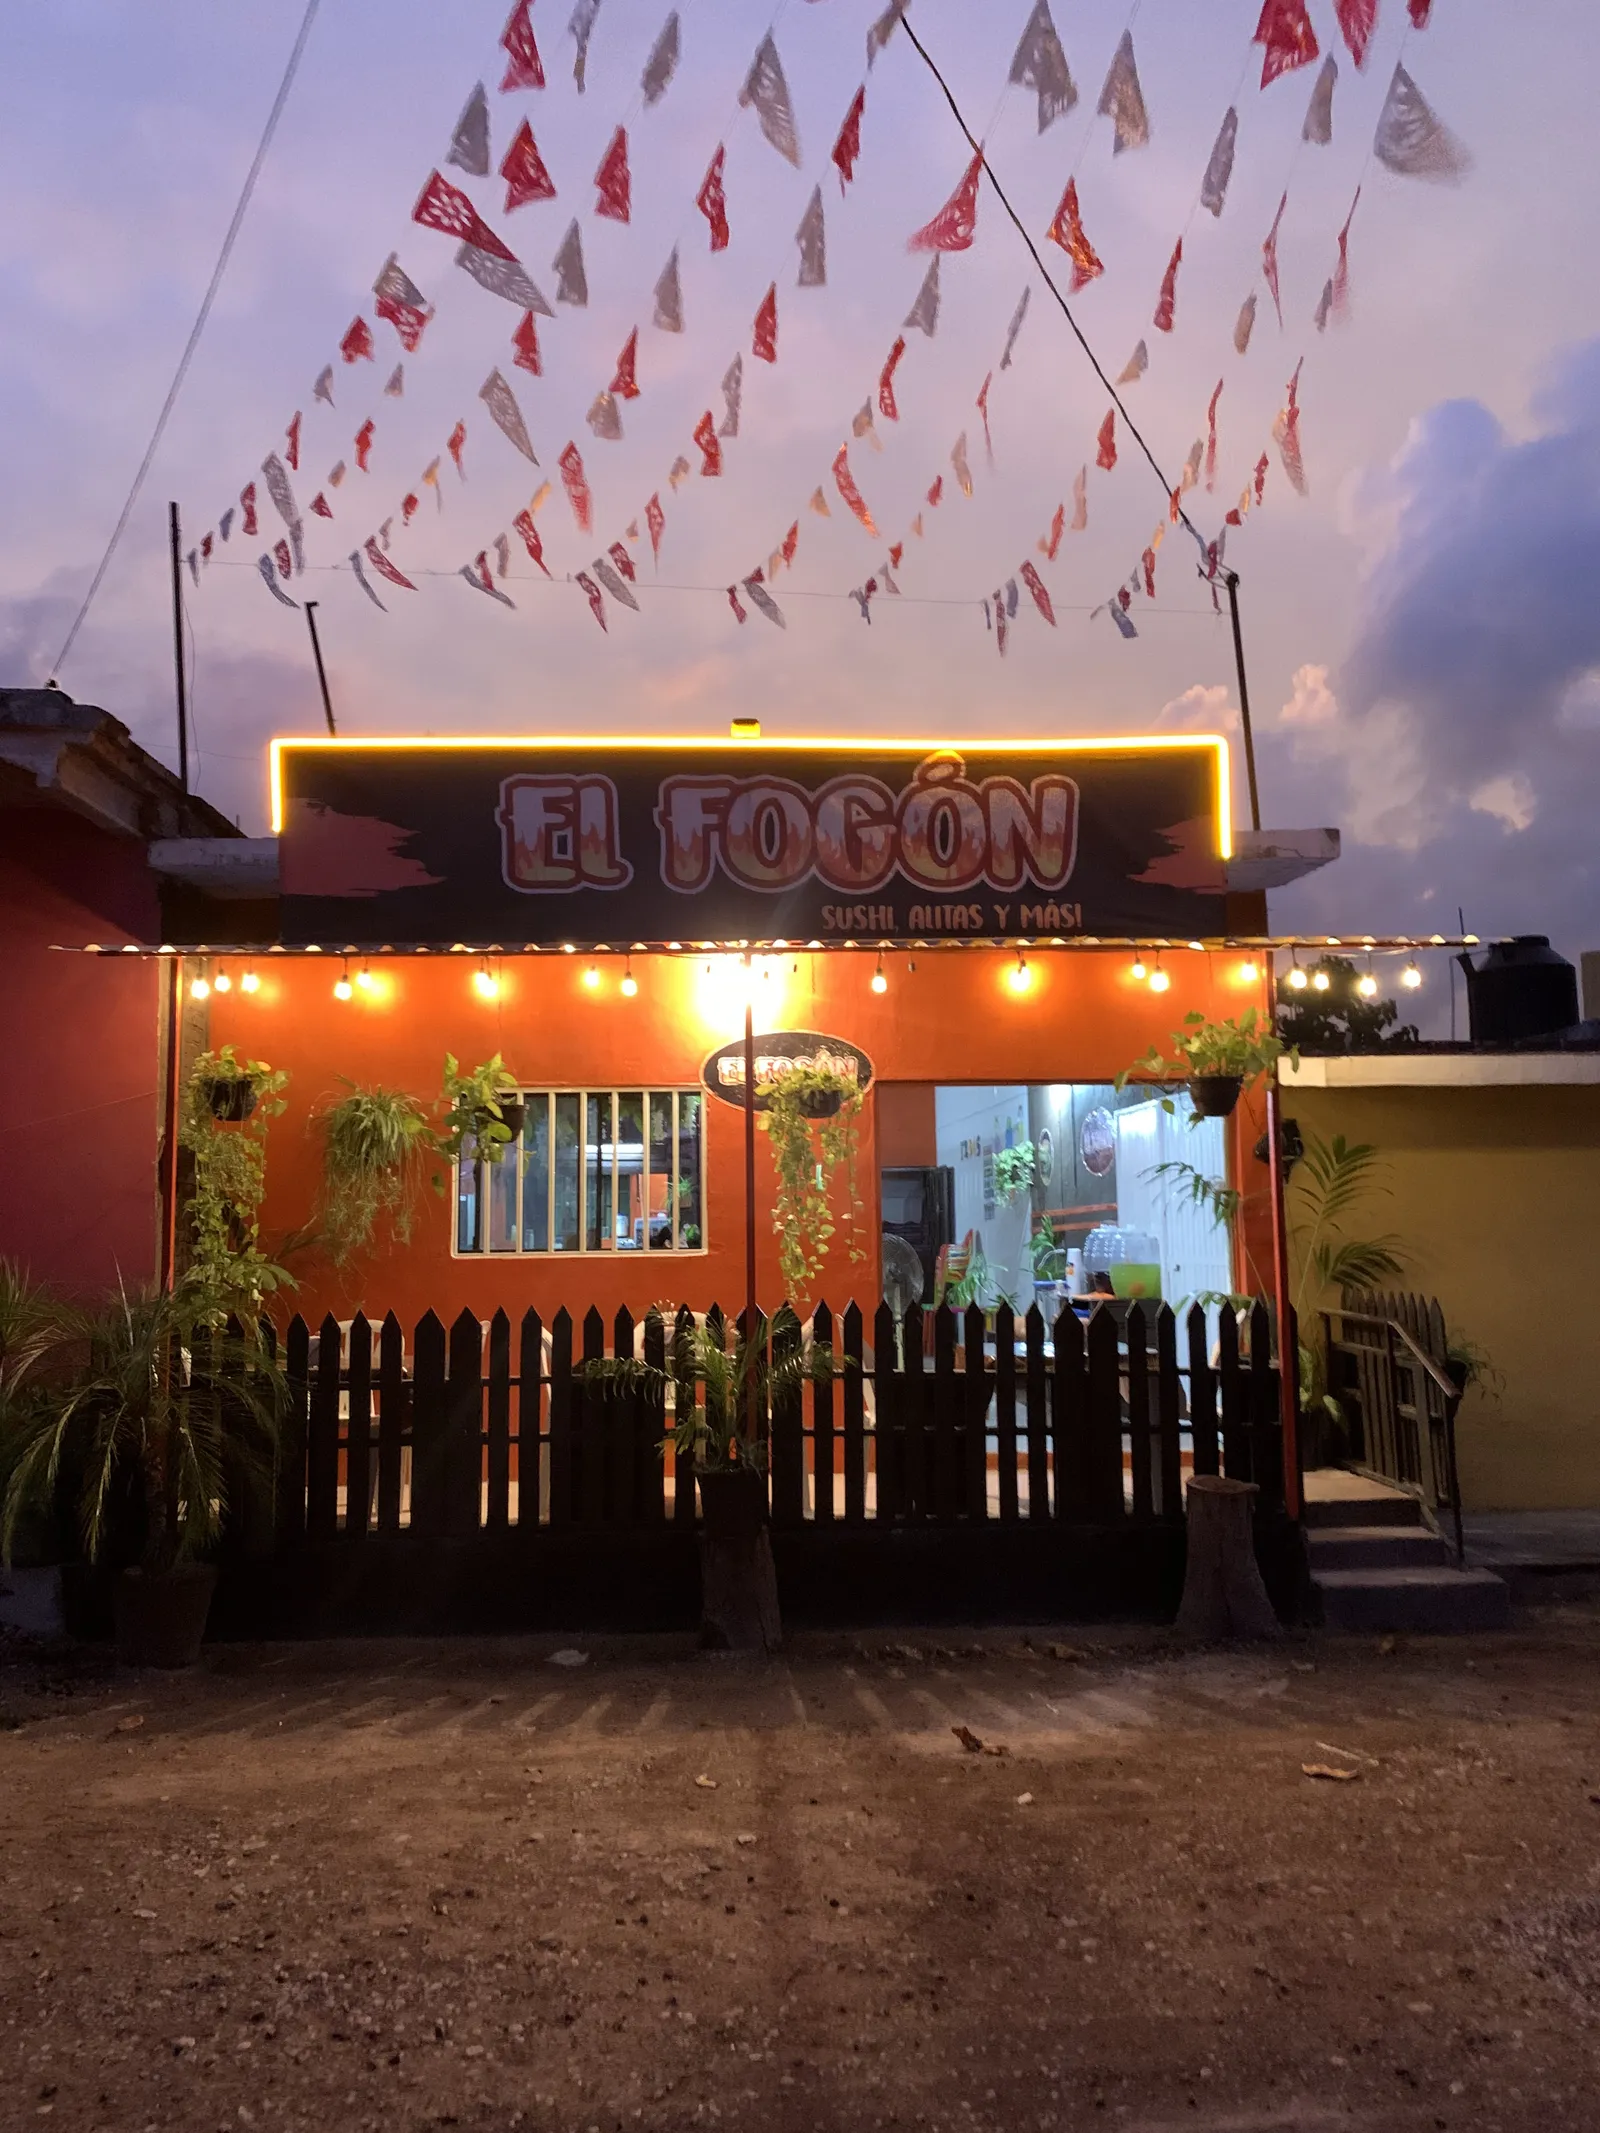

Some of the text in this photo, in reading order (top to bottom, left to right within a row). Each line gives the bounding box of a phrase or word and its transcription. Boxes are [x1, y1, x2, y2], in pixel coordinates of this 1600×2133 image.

[495, 749, 1080, 894] EL FOGÓN
[908, 904, 984, 930] ALITAS
[993, 904, 1011, 930] Y
[1020, 898, 1082, 930] MÁS!
